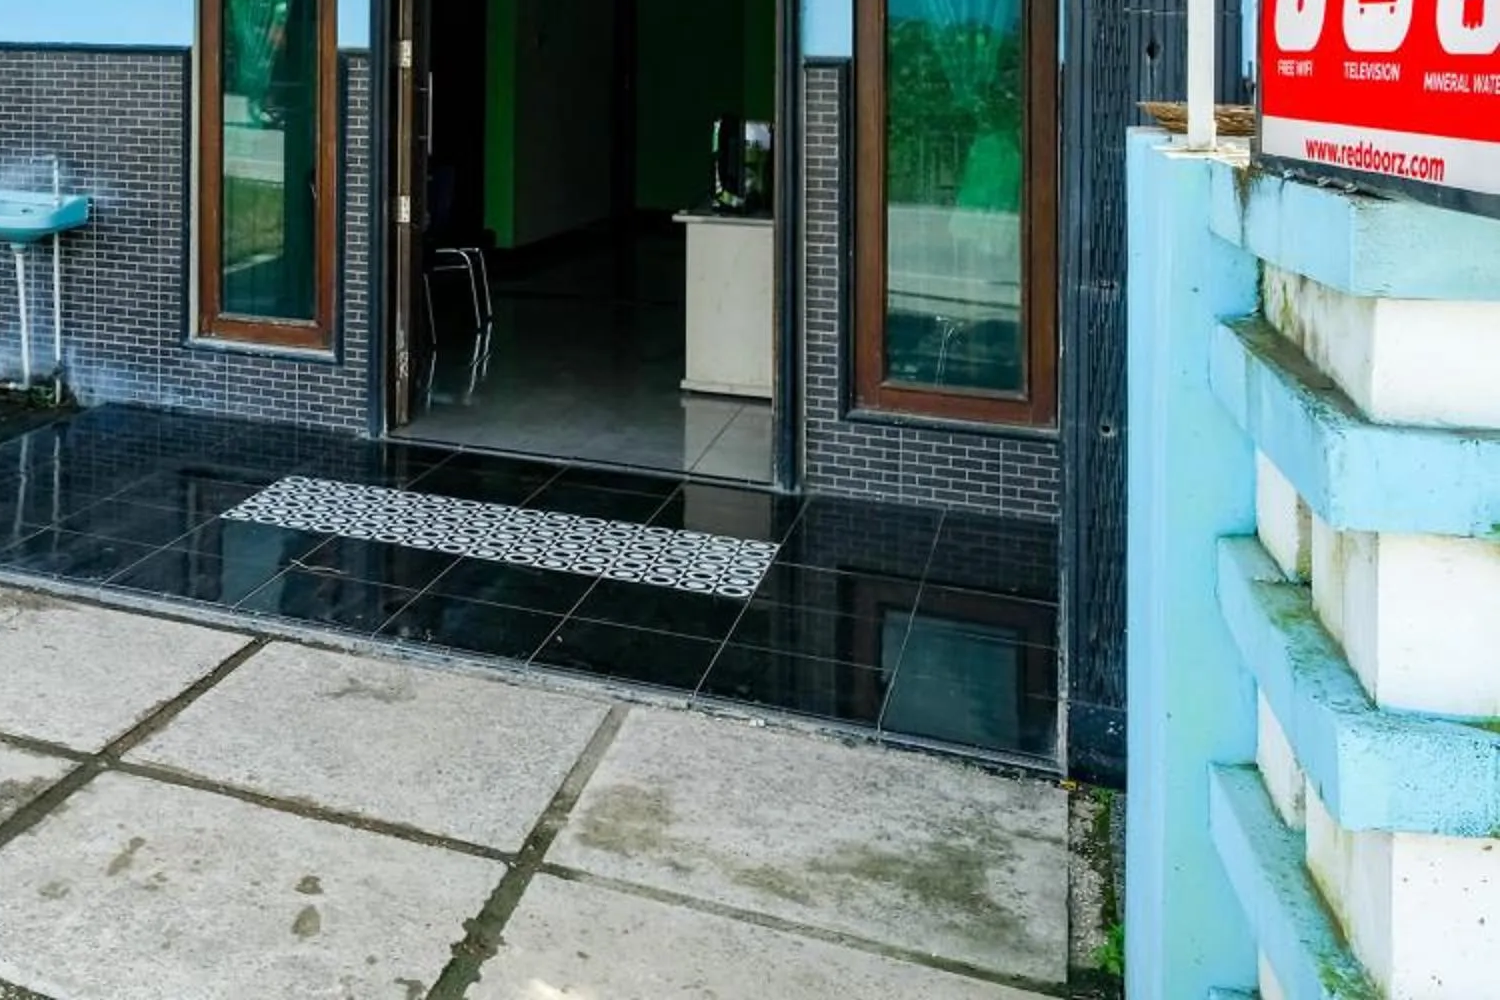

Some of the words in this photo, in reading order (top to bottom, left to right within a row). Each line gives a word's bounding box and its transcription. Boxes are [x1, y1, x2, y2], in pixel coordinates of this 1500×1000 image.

[1277, 59, 1295, 76] FREE
[1343, 61, 1401, 82] TELEVISION
[1423, 71, 1470, 93] MINERAL
[1305, 138, 1446, 182] www.reddoorz.com
